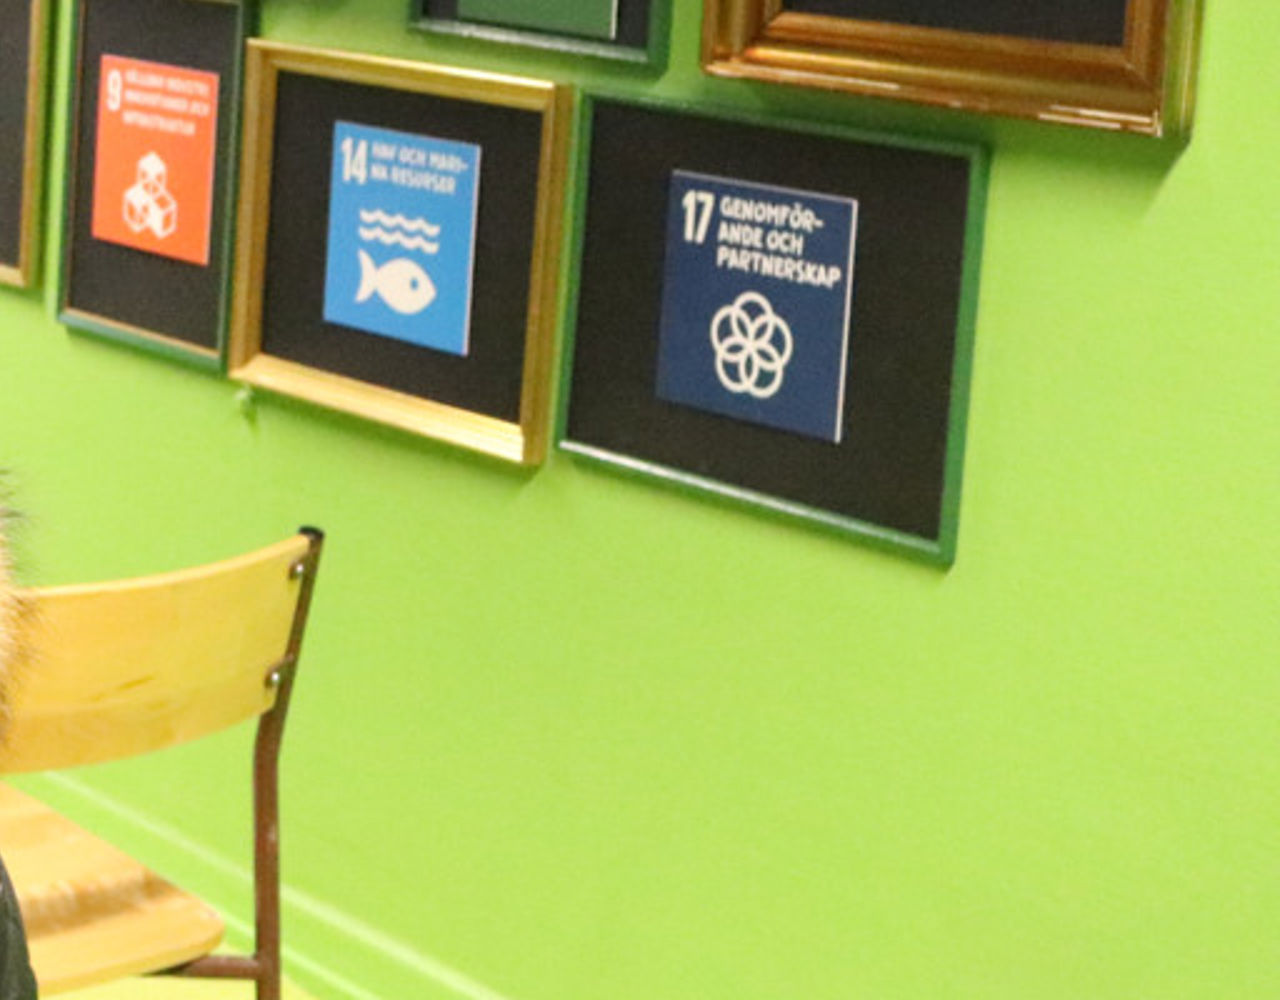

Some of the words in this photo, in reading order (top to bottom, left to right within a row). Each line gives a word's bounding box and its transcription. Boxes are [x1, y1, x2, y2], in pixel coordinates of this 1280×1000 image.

[107, 69, 122, 112] 9
[342, 137, 368, 184] 14
[399, 146, 426, 165] OCH
[682, 190, 715, 243] 17
[720, 195, 824, 233] GENOMFÖR-
[718, 221, 763, 248] ANDE
[766, 230, 803, 255] OCH
[716, 245, 841, 288] PARTNERSKAP
